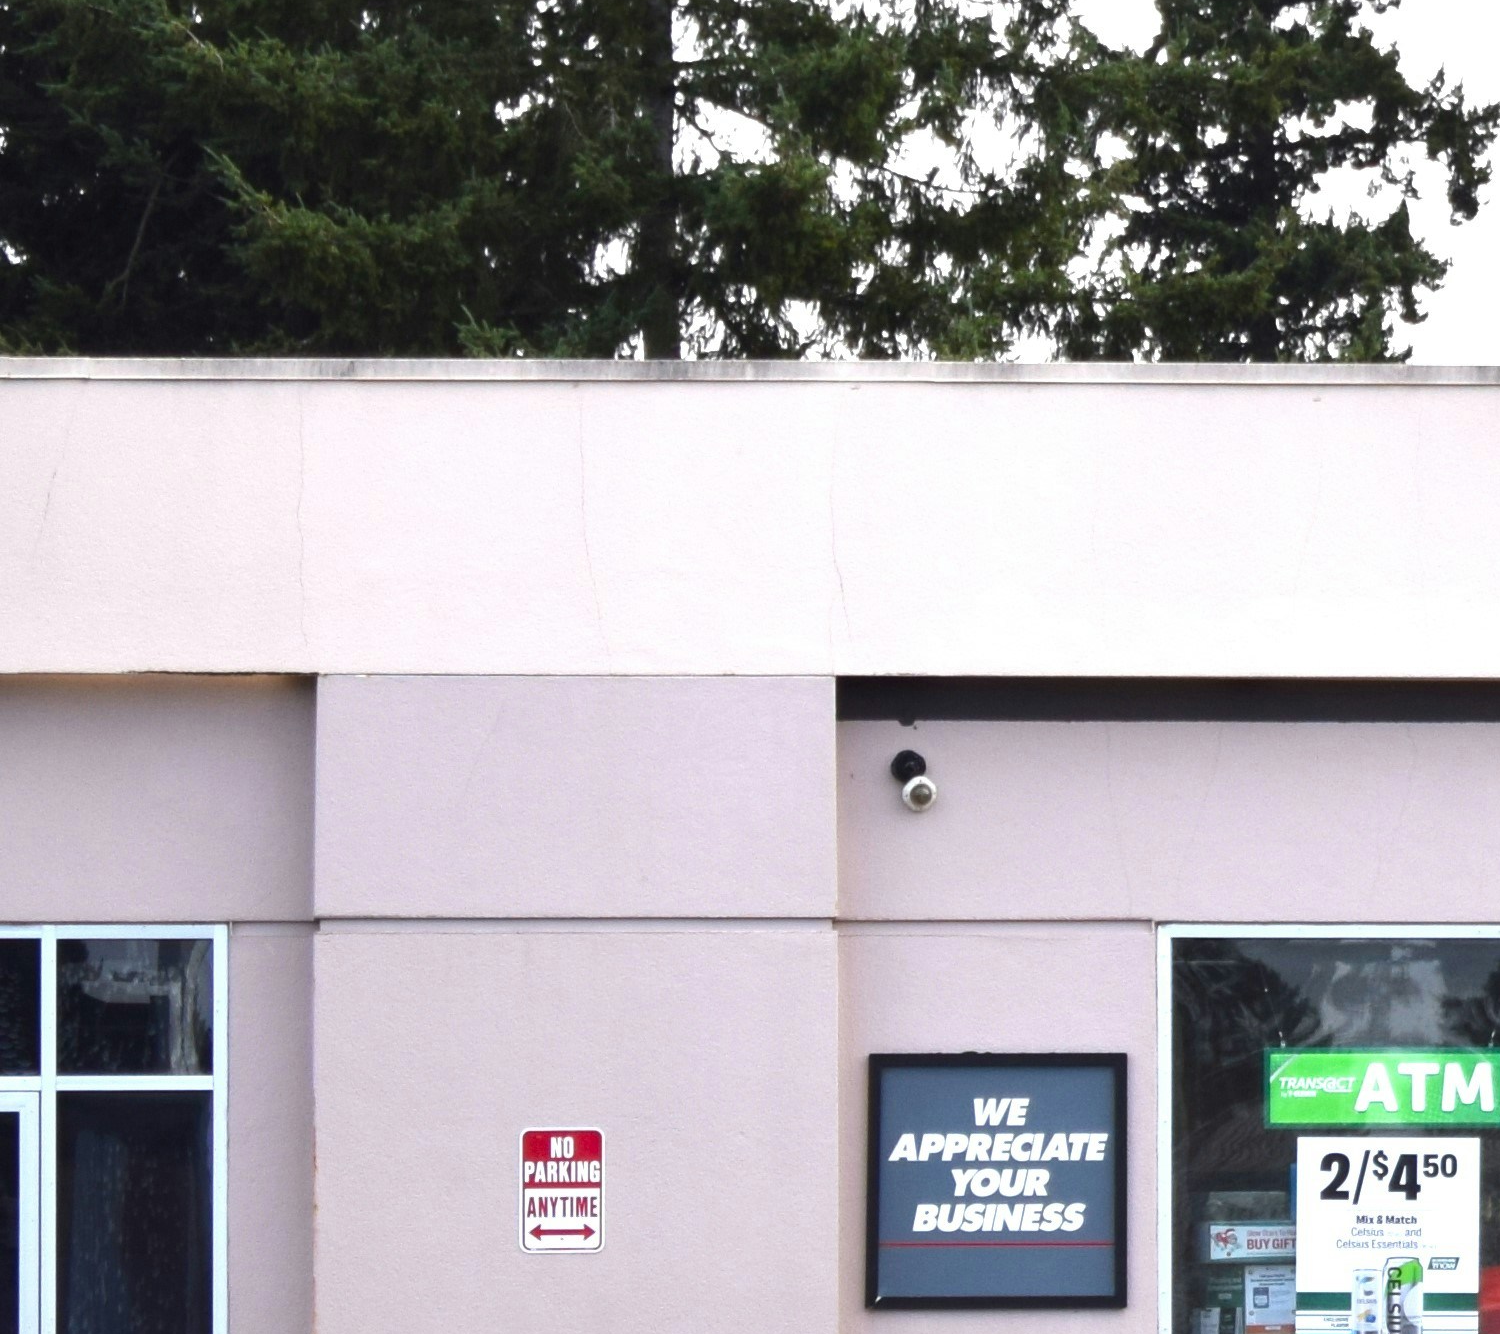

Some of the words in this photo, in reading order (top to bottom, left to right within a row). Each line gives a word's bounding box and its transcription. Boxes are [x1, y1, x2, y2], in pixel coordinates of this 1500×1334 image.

[1354, 1062, 1495, 1112] ATM
[973, 1098, 1030, 1126] WE
[550, 1136, 574, 1158] NO
[888, 1133, 1108, 1162] APPRECIATE
[524, 1161, 600, 1182] PARKING
[951, 1168, 1050, 1197] YOUR
[527, 1197, 598, 1217] ANYTIME
[912, 1203, 1086, 1232] BUSINESS
[1356, 1216, 1374, 1224] Mix
[1385, 1216, 1417, 1224] Match
[1351, 1227, 1384, 1237] Celsius
[1405, 1228, 1422, 1237] and
[1247, 1239, 1269, 1250] BUY
[1336, 1240, 1369, 1249] Celsius
[1372, 1240, 1418, 1249] Essentials
